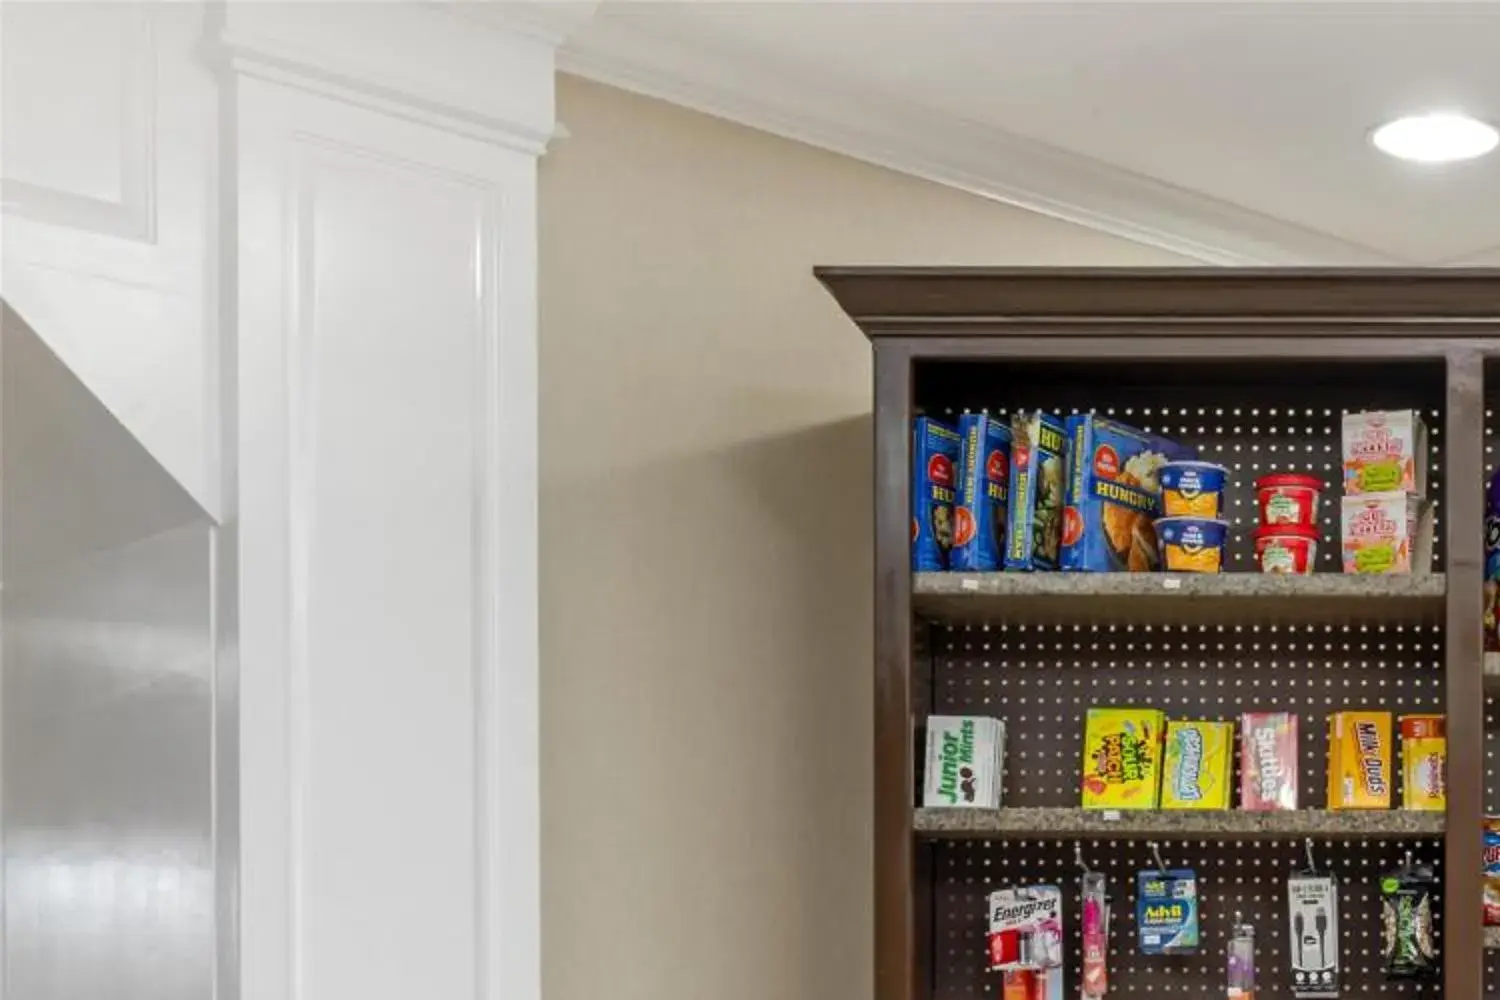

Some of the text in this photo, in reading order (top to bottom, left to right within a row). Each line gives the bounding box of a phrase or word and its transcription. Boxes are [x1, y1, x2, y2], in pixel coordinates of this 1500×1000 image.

[960, 719, 975, 764] Mints
[1121, 734, 1139, 781] SOUR
[1255, 727, 1282, 801] Skittles
[937, 730, 959, 804] Junior
[993, 899, 1057, 922] Energizer
